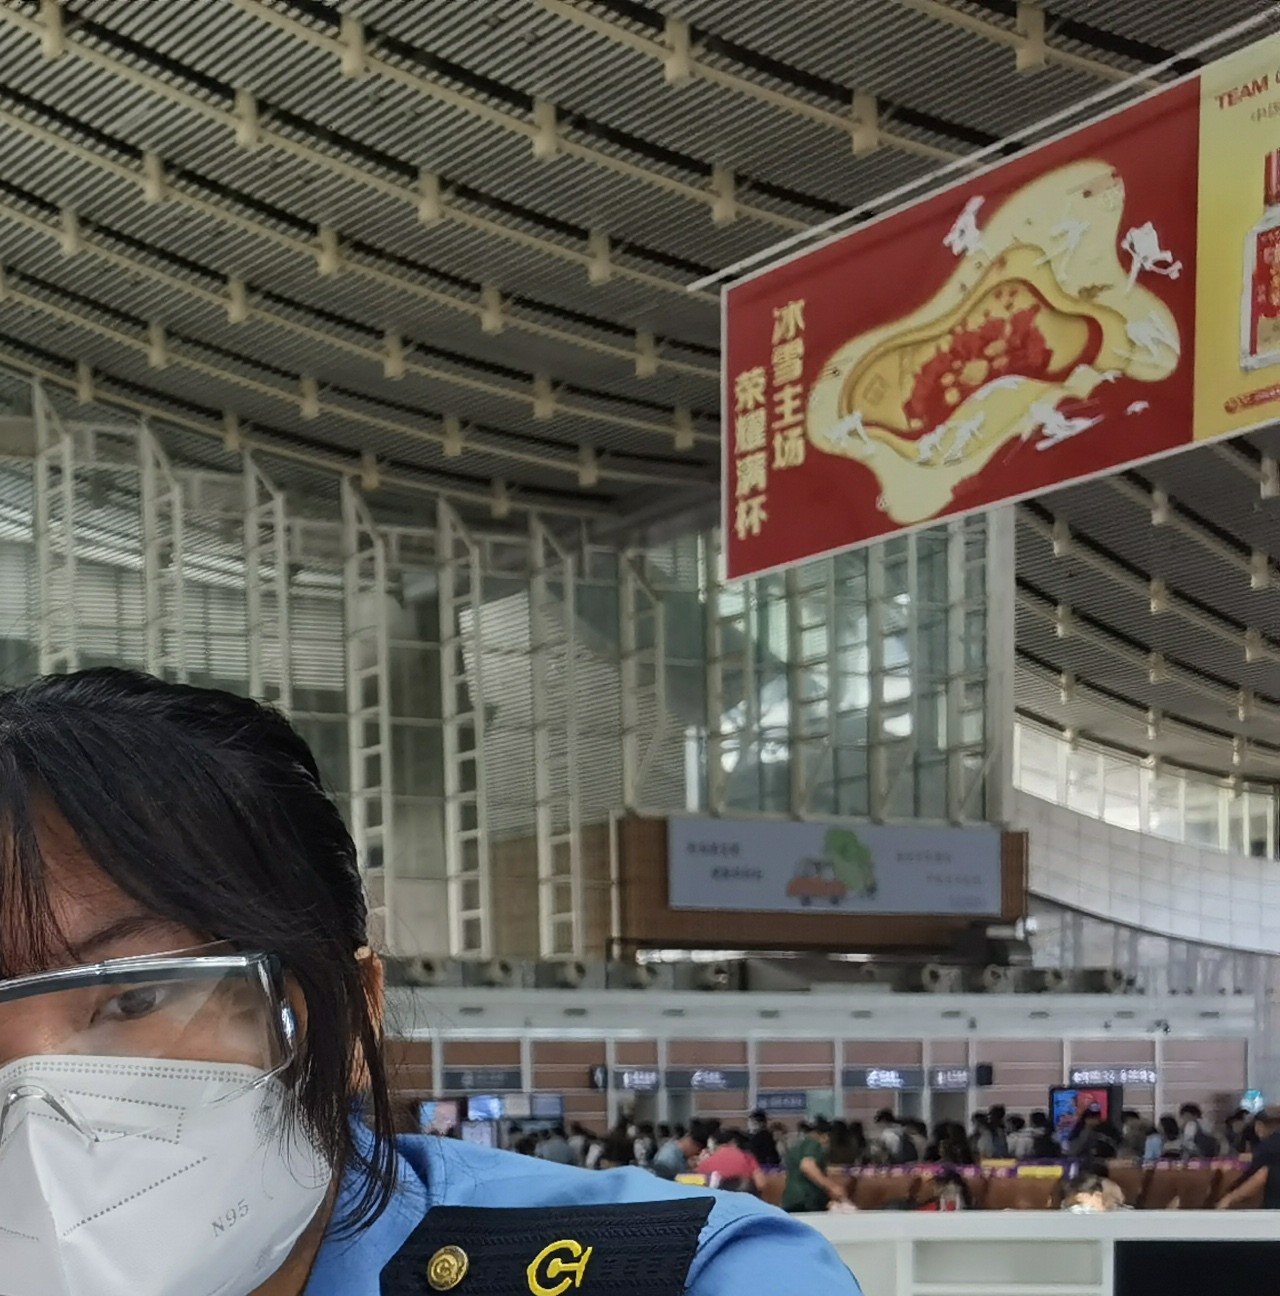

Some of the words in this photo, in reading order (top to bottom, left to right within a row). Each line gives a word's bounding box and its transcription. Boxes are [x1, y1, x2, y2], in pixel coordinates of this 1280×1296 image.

[1215, 74, 1269, 110] TEAM
[772, 298, 806, 470] 冰雪主场
[734, 366, 768, 541] 荣耀满杯
[211, 1198, 249, 1237] N95
